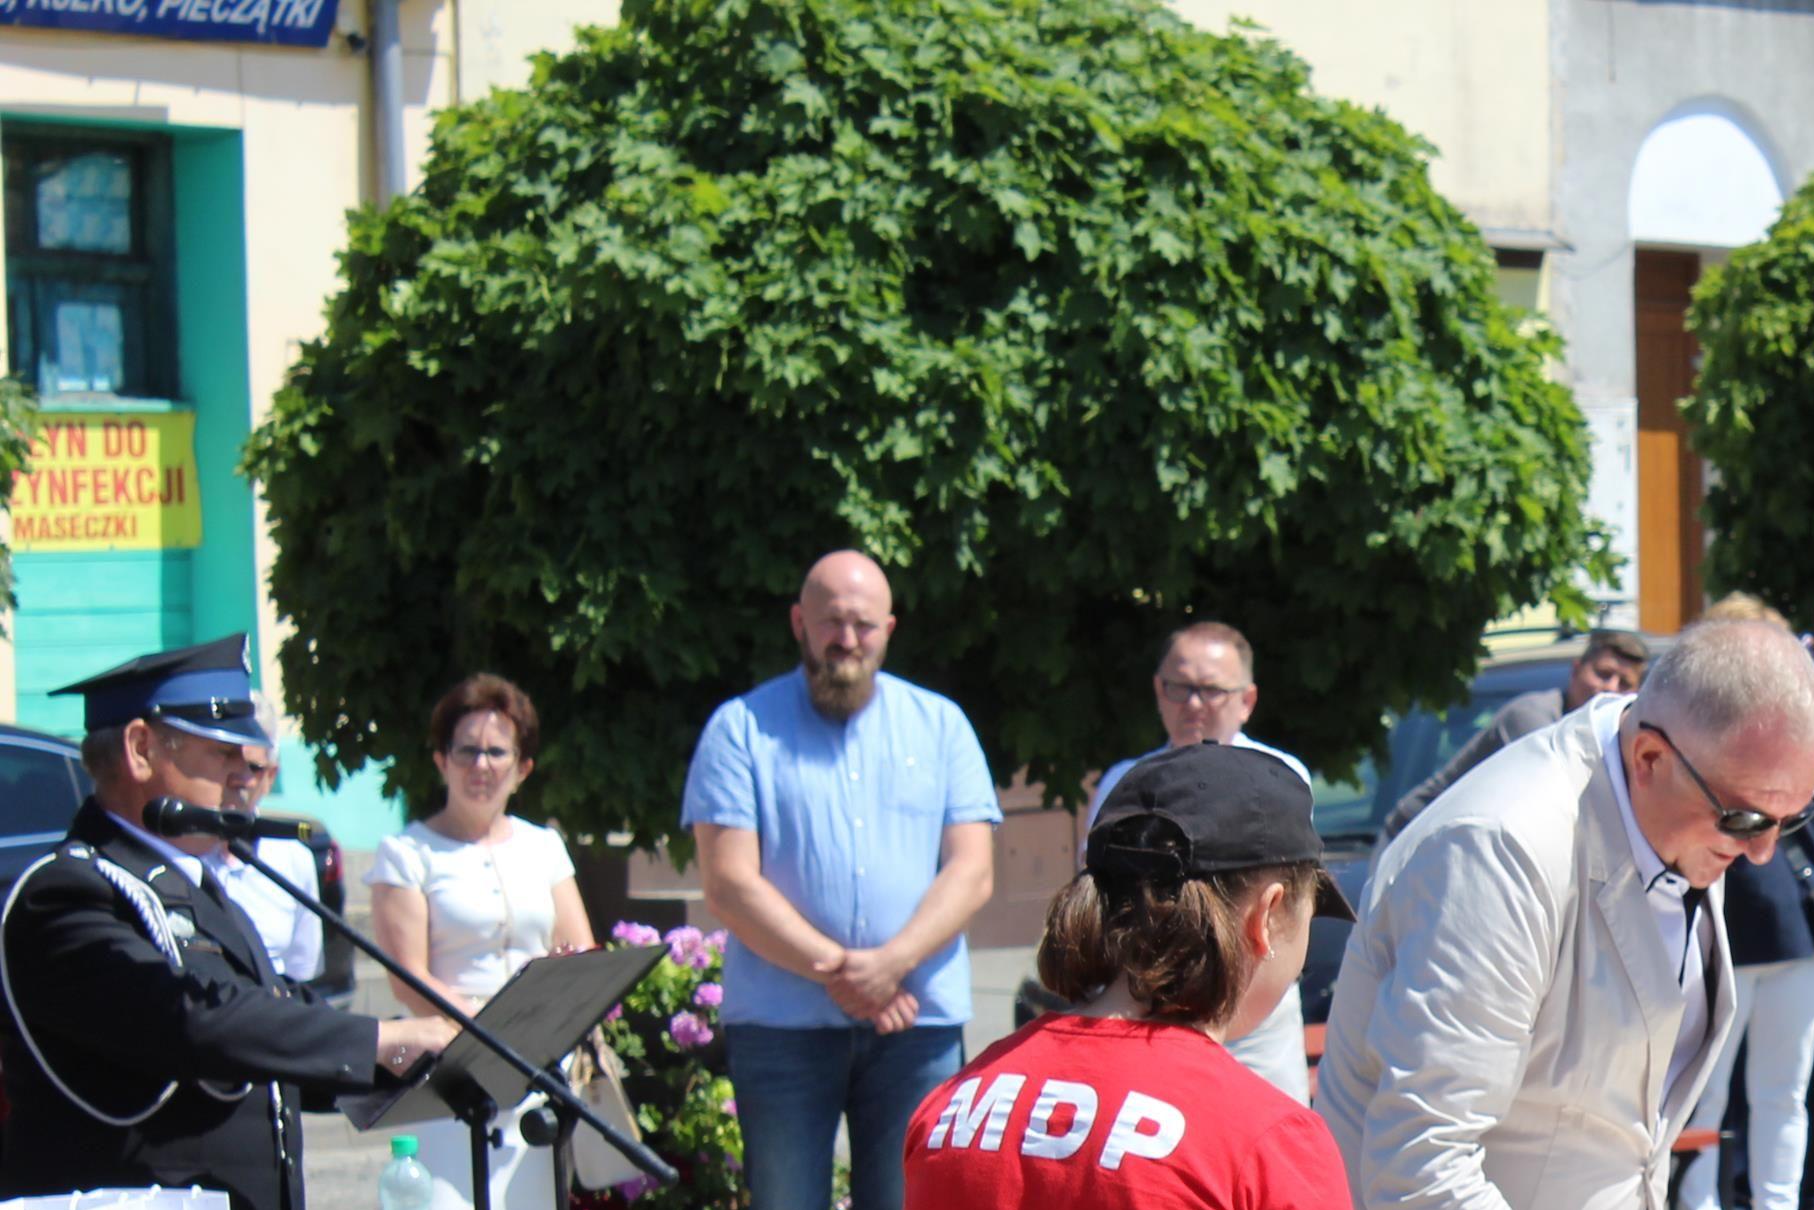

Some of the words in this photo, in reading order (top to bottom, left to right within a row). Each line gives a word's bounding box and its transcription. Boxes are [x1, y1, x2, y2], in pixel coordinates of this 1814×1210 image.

[103, 420, 147, 458] DO
[14, 514, 137, 541] MASECZKI
[927, 1073, 1186, 1171] MDP
